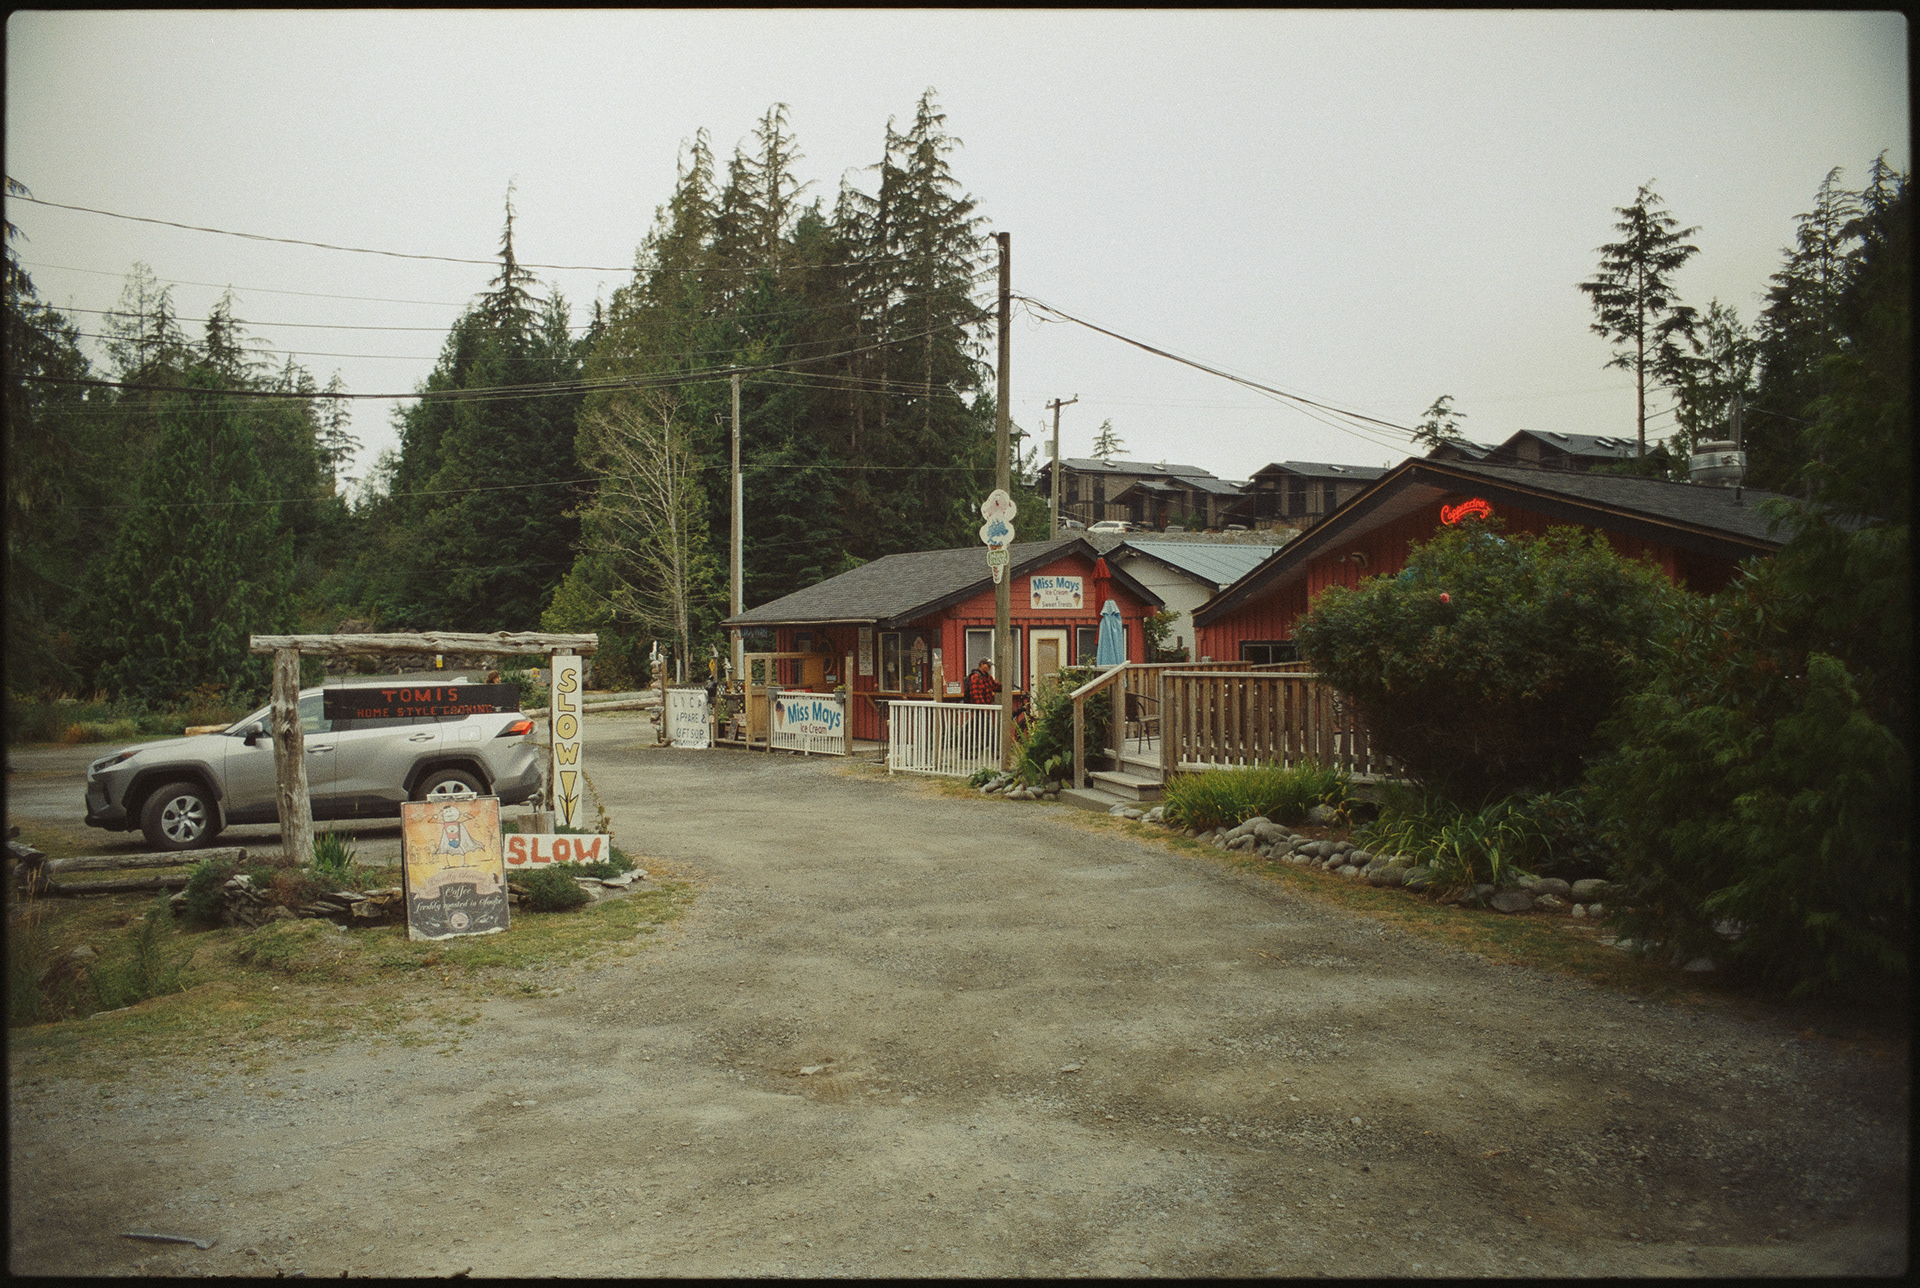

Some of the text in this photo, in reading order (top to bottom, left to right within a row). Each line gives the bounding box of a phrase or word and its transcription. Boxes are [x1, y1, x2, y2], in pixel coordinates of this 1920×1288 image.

[1033, 577, 1079, 592] Miss Mays
[382, 688, 458, 702] TOMIS
[357, 703, 494, 718] HOME STYLE COOKING
[555, 668, 580, 765] SLOW
[787, 701, 841, 731] Miss Mays
[800, 723, 828, 734] Ice Cream
[507, 836, 602, 865] SLOW
[445, 884, 472, 899] Coffee
[414, 900, 442, 914] freshly
[470, 898, 478, 907] in
